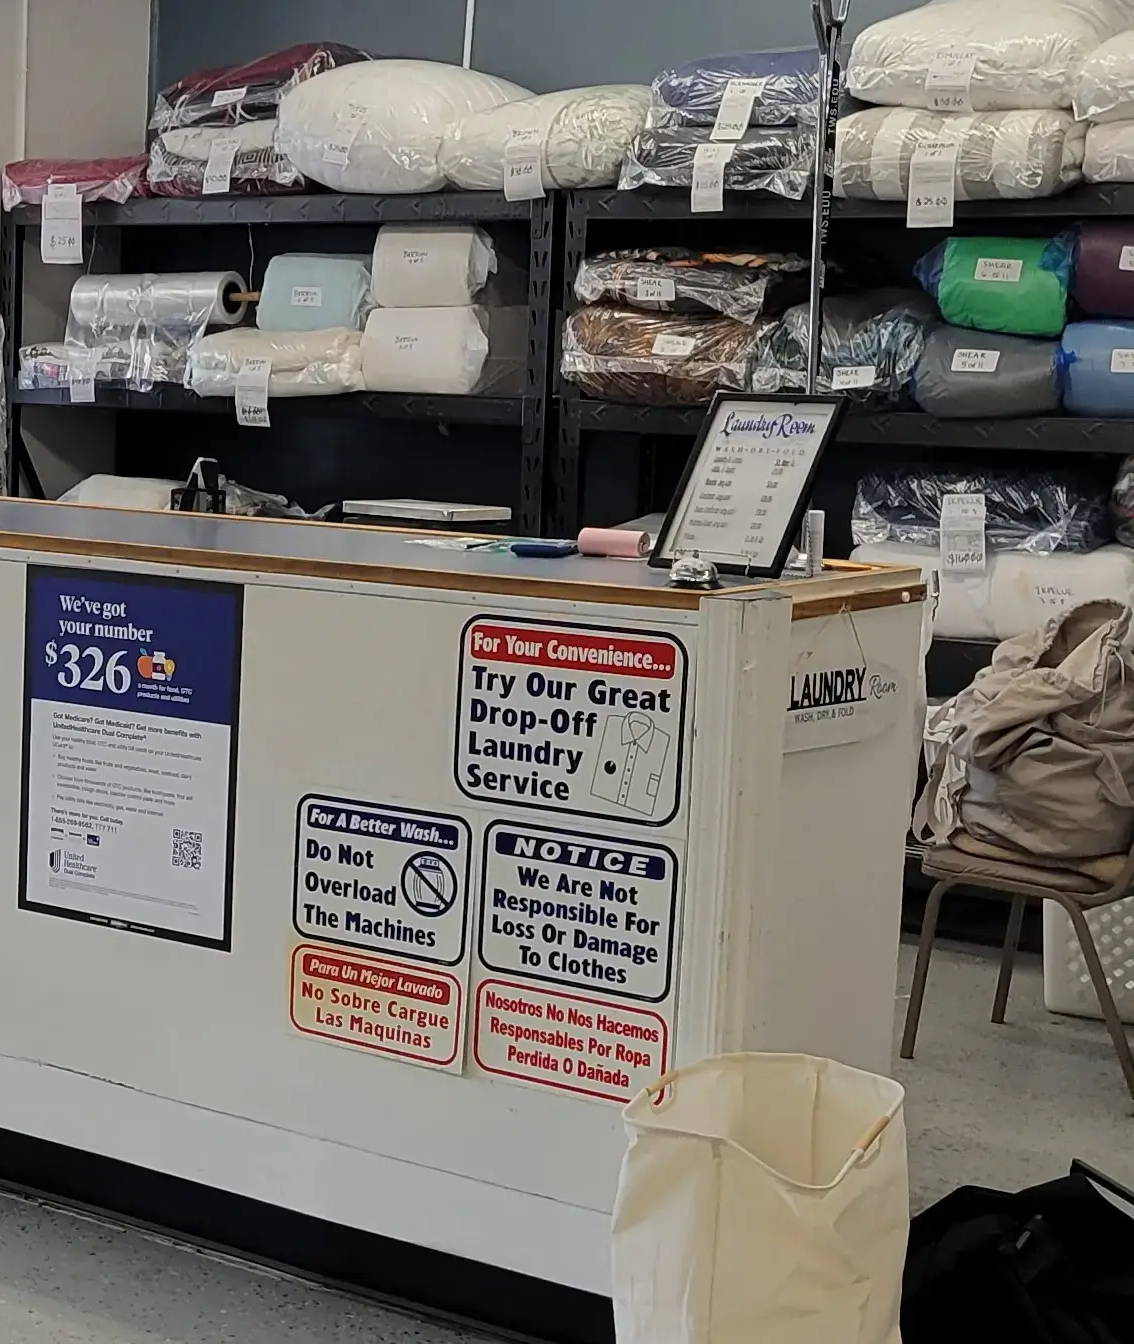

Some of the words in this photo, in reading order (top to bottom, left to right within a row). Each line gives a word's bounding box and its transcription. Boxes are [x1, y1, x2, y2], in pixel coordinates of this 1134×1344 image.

[828, 78, 839, 135] TWS.EDU
[641, 279, 662, 287] SHEAR
[957, 351, 986, 359] SHEAR
[720, 411, 774, 439] Laundry
[776, 414, 815, 438] Room
[59, 595, 101, 614] We've
[103, 603, 126, 619] got
[59, 619, 92, 636] your
[94, 623, 153, 642] number
[45, 639, 131, 694] $326
[473, 632, 500, 652] For
[505, 635, 543, 657] Your
[547, 640, 671, 672] Convenience...
[472, 665, 516, 699] Try
[526, 672, 577, 700] Our
[588, 679, 671, 712] Great
[791, 667, 866, 709] LAUNDRY
[869, 675, 898, 699] Room
[470, 698, 597, 737] Drop-Off
[838, 706, 854, 717] FOLD
[469, 731, 583, 774] Laundry
[467, 763, 569, 800] Service
[310, 808, 334, 826] For
[335, 813, 346, 828] A
[349, 815, 396, 835] Better
[400, 822, 454, 845] Wash...
[64, 850, 84, 861] United
[306, 838, 331, 861] Do
[338, 844, 374, 869] Not
[514, 837, 649, 875] NOTICE
[305, 871, 396, 906] Overload
[517, 866, 549, 889] We
[556, 873, 592, 897] Are
[600, 880, 638, 905] Not
[304, 903, 339, 928] The
[345, 911, 436, 946] Machines
[494, 889, 617, 928] Responsible
[625, 912, 660, 936] For
[492, 914, 535, 939] Loss
[542, 923, 567, 945] Or
[574, 929, 658, 965] Damage
[310, 959, 339, 976] Para
[341, 966, 358, 981] Un
[360, 969, 395, 989] Mejor
[397, 977, 443, 999] Lavado
[519, 945, 541, 966] To
[548, 951, 626, 984] Clothes
[302, 982, 324, 1000] No
[331, 988, 380, 1013] Sobre
[388, 1001, 449, 1029] Cargue
[486, 991, 542, 1018] Nosotros
[547, 1003, 564, 1022] No
[568, 1008, 592, 1028] Nos
[597, 1014, 658, 1042] Hacemos
[316, 1007, 343, 1027] Las
[350, 1015, 431, 1048] Maquinas
[491, 1017, 583, 1051] Responsables
[588, 1038, 612, 1058] Por
[616, 1044, 650, 1068] Ropa
[508, 1045, 558, 1072] Perdida
[563, 1057, 573, 1074] O
[578, 1060, 629, 1087] Dañada
